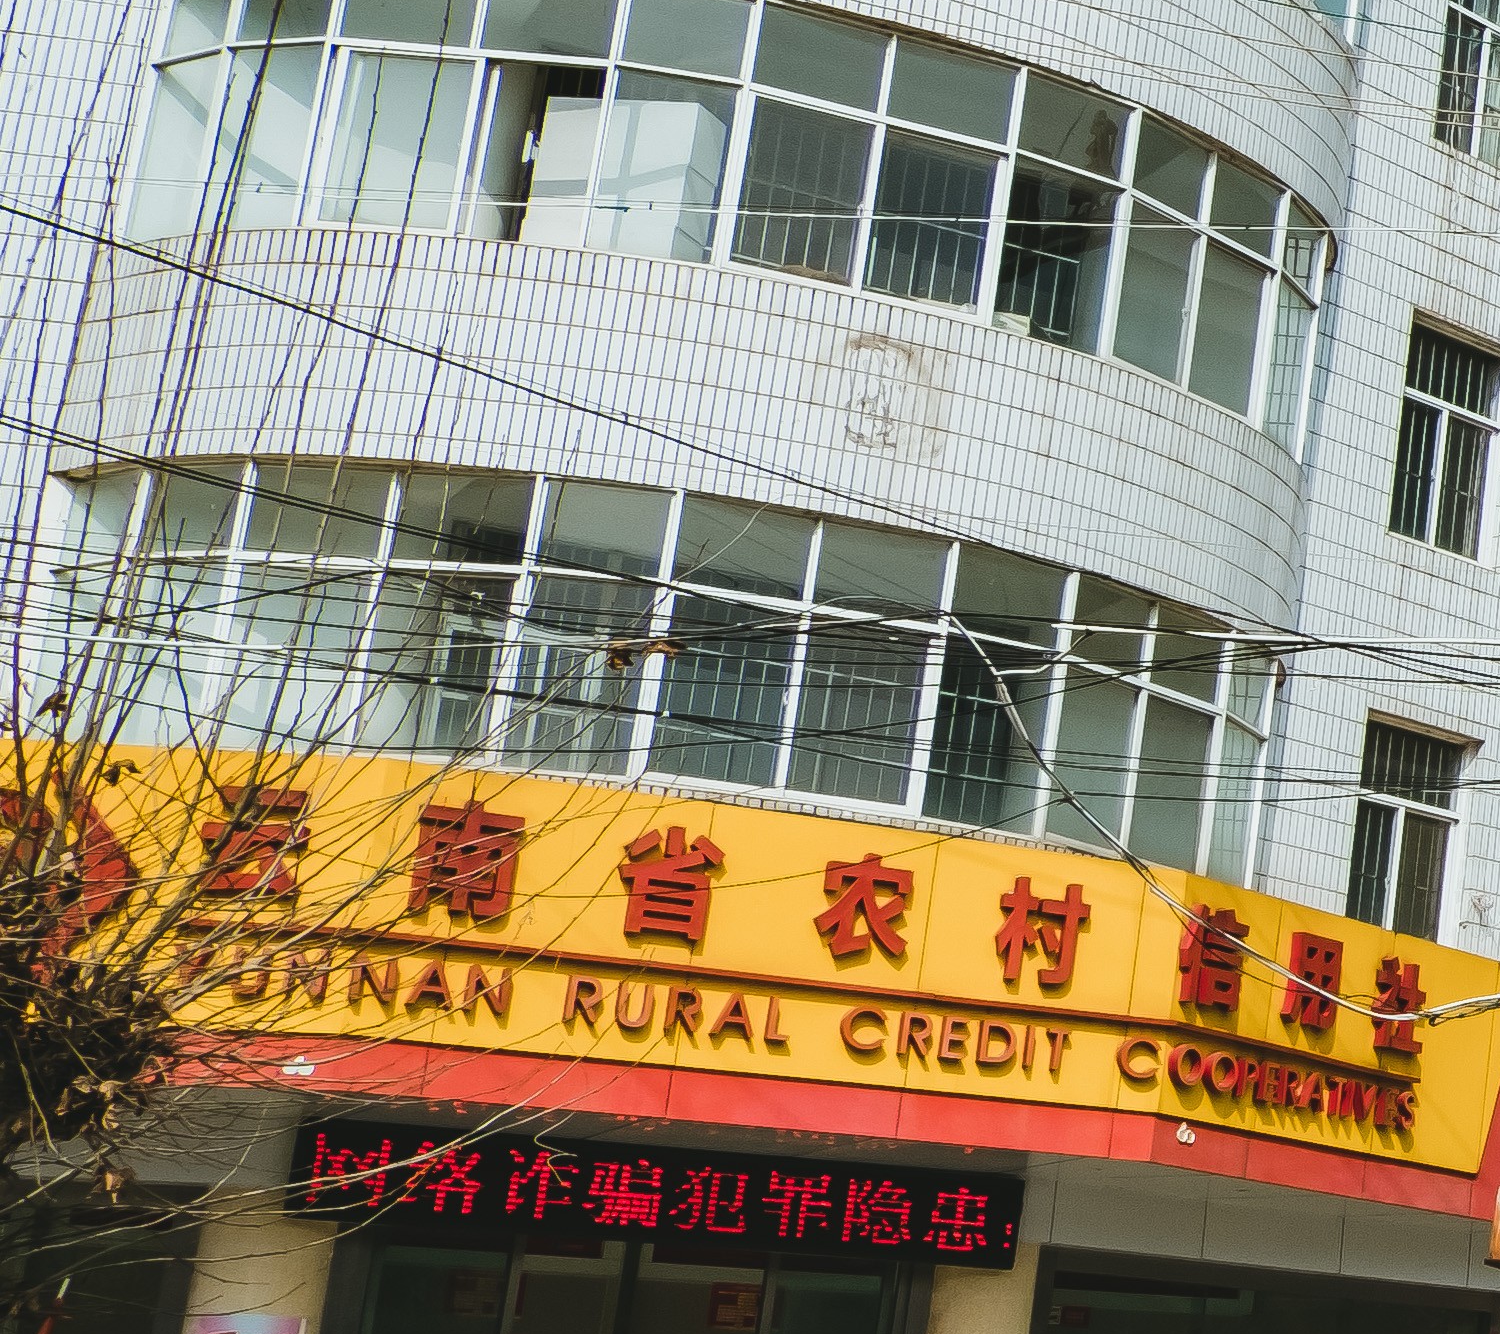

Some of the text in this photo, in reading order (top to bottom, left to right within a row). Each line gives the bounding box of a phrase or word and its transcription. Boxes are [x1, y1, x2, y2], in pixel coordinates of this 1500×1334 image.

[200, 784, 1427, 1055] 云南省农村信用社
[175, 943, 1418, 1132] YUNNAN RURAL CREDIT COOPERATIVES
